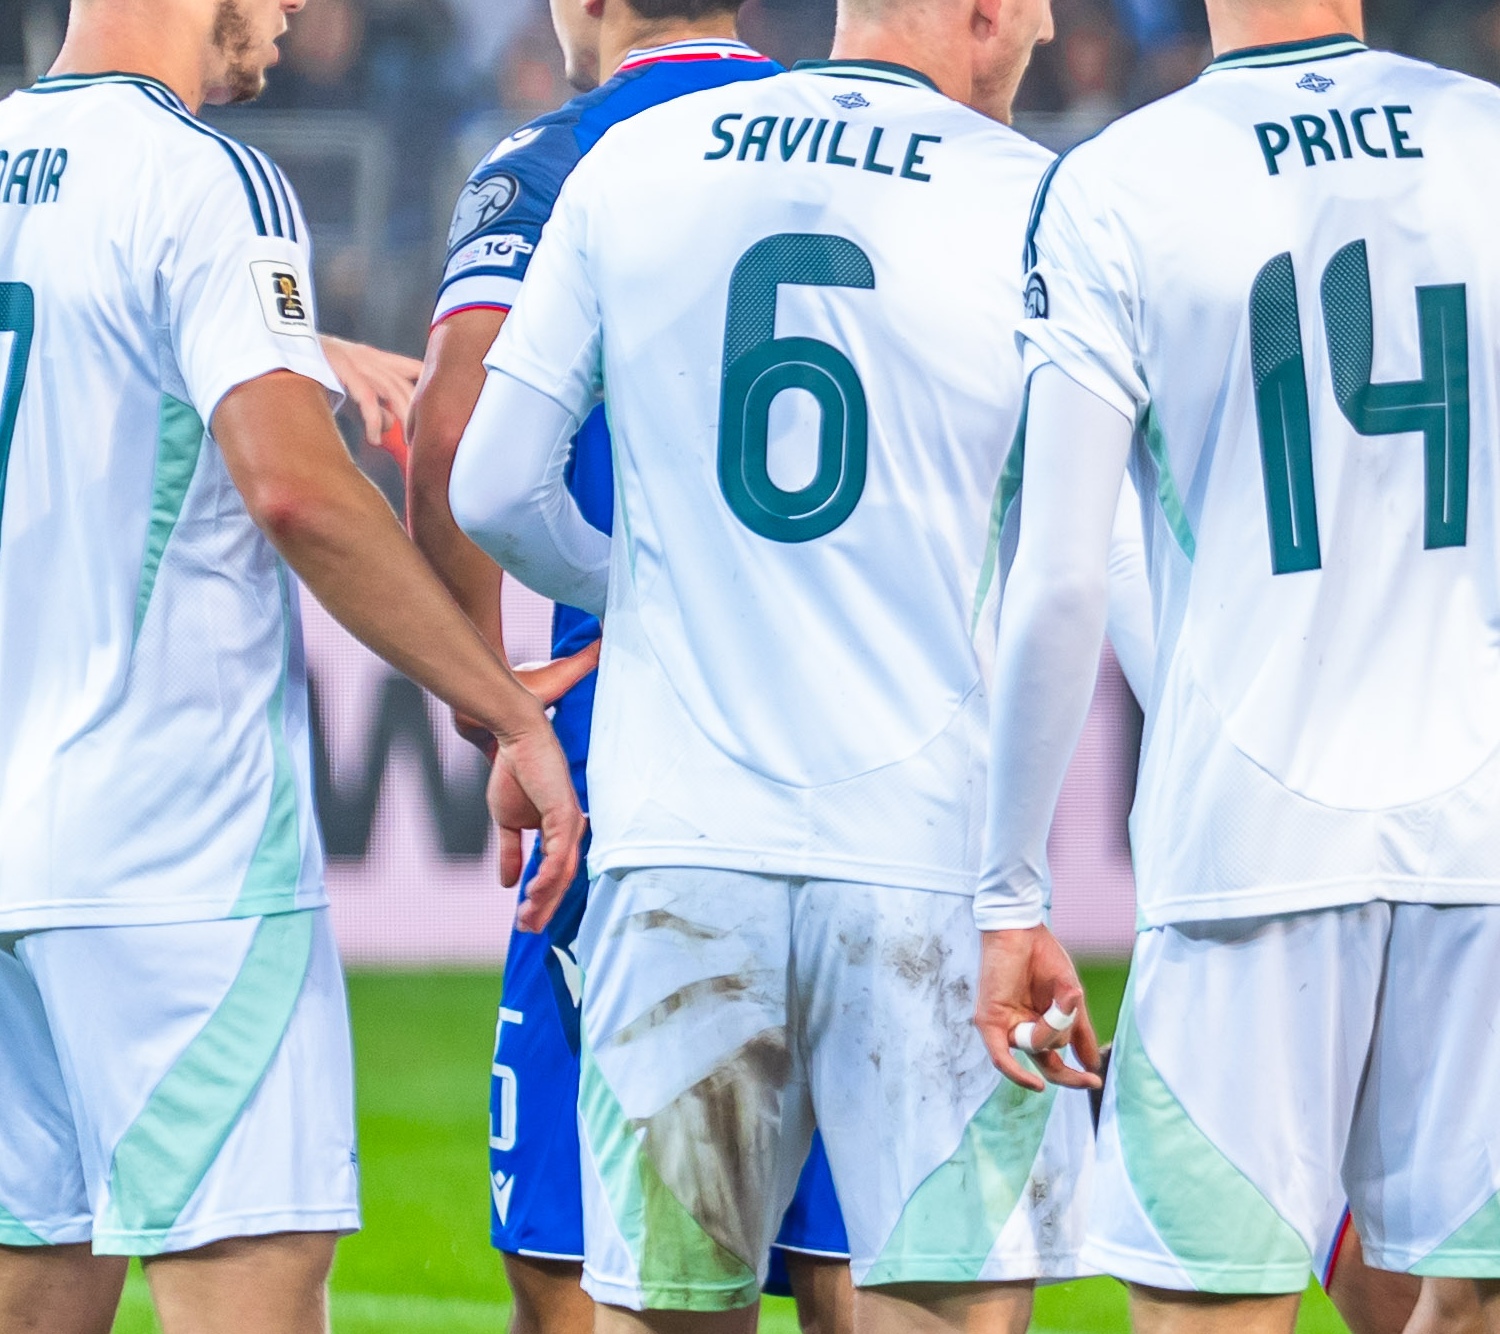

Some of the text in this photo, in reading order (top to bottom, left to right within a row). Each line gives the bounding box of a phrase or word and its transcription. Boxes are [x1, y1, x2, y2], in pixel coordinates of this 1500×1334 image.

[703, 113, 942, 183] SAVILLE
[1253, 105, 1425, 177] PRICE
[716, 232, 876, 545] 6
[1248, 238, 1470, 576] 14
